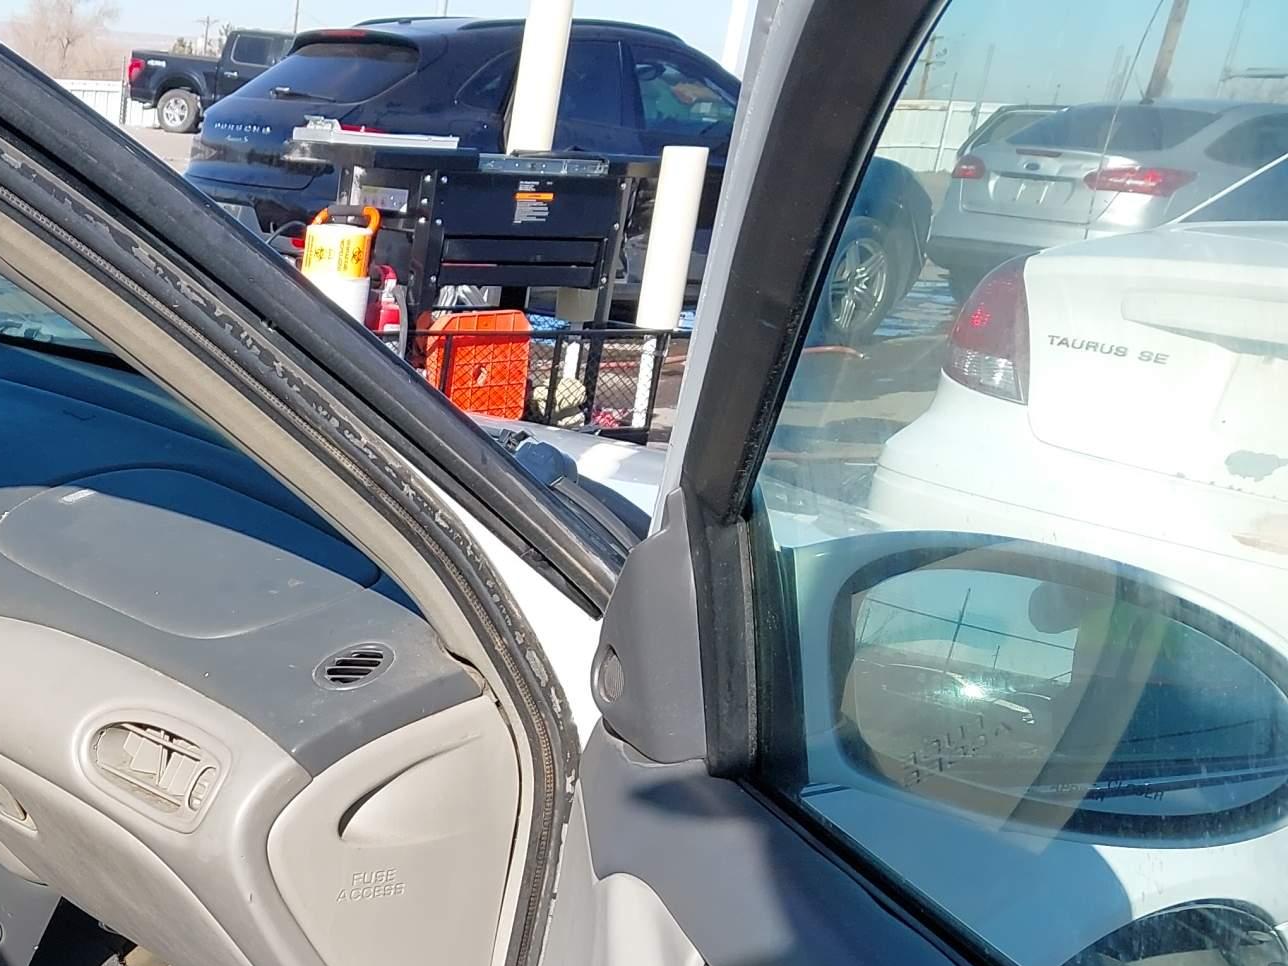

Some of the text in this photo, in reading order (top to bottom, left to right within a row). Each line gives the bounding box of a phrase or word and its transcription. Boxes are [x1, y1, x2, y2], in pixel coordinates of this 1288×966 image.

[1047, 334, 1171, 365] TAURUS SE
[351, 867, 399, 887] FUSE
[336, 882, 407, 904] ACCESS
